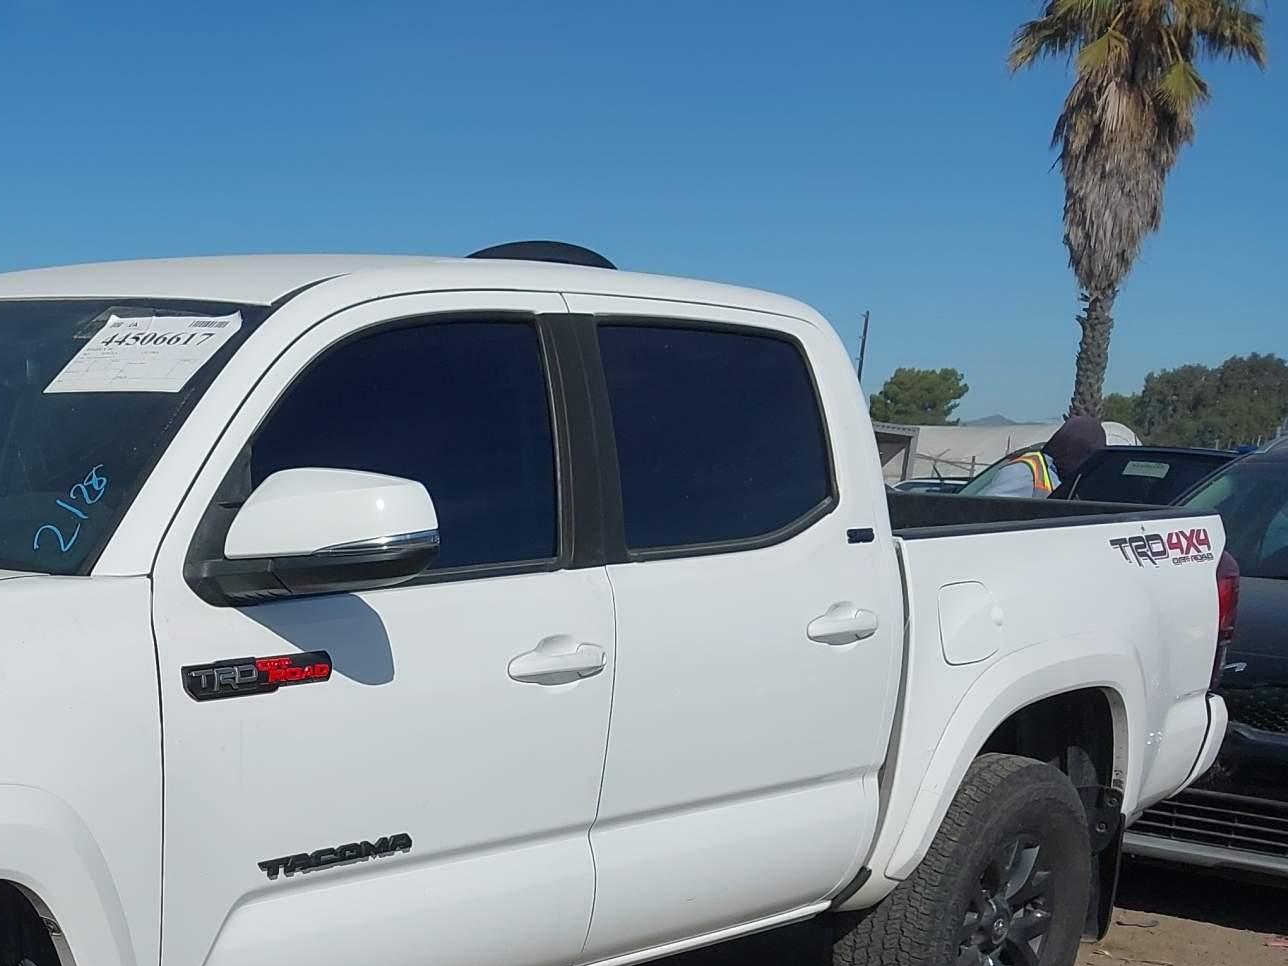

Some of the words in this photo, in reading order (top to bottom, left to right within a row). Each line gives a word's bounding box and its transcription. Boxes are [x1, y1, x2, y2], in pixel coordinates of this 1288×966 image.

[101, 332, 216, 346] 44506617
[1109, 533, 1170, 568] TRD
[188, 664, 258, 692] TRD
[257, 833, 412, 880] TACOMA
